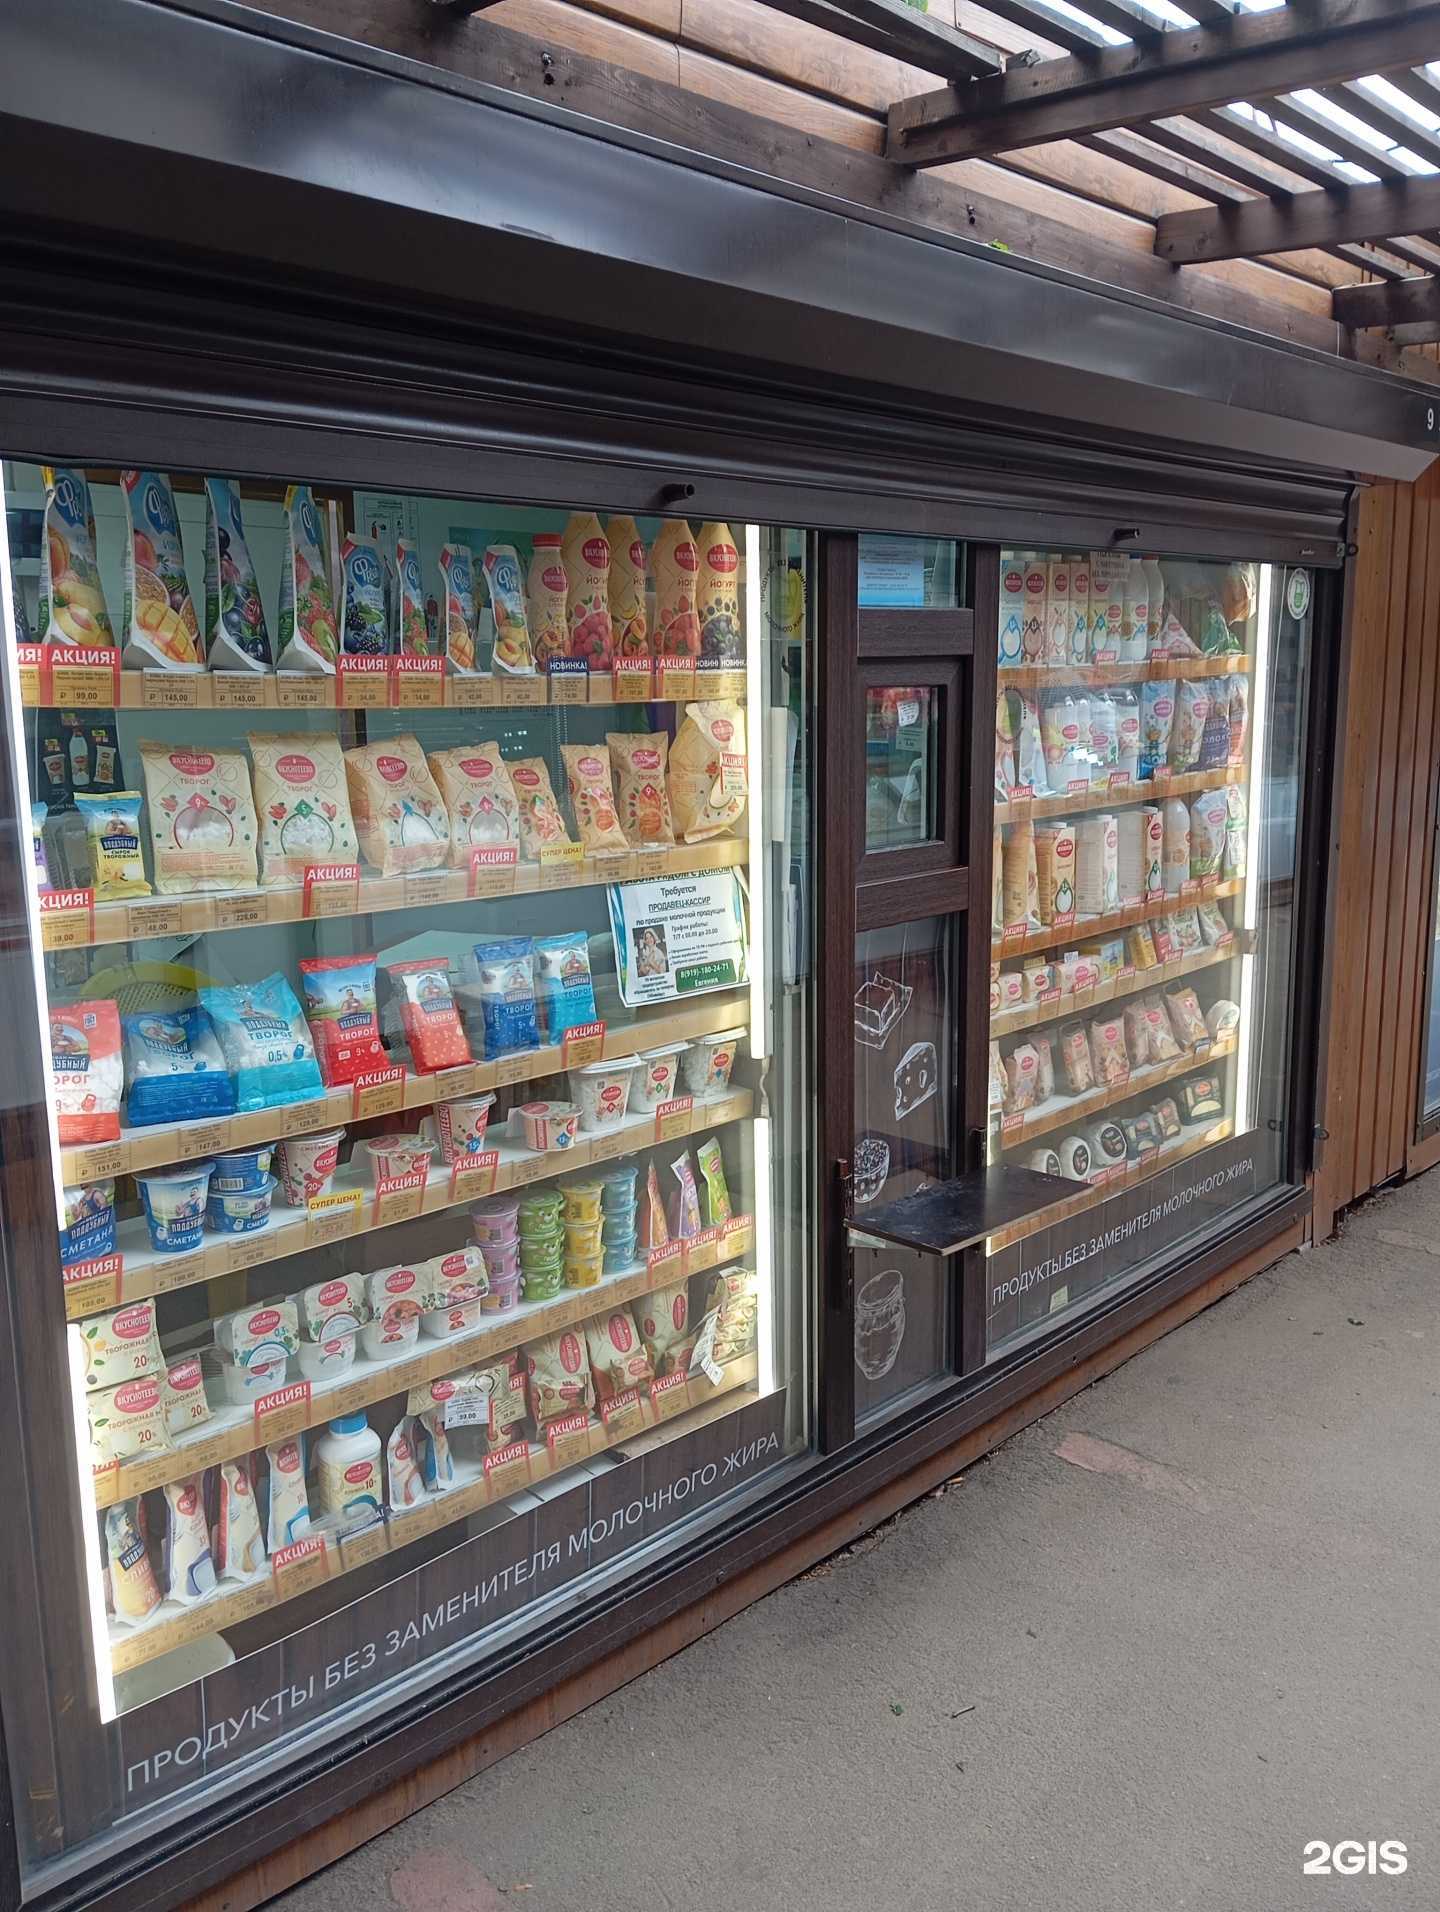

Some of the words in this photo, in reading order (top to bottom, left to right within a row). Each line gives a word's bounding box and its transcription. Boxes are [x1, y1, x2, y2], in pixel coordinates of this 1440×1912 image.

[1427, 407, 1434, 431] 9
[51, 650, 115, 665] АКЦИЯ!
[340, 659, 388, 671] АКЦИЯ!
[396, 658, 442, 671] АКЦИЯ!
[550, 661, 587, 670] НОВИНКА!
[615, 660, 652, 670] АКЦИЯ!
[660, 659, 694, 669] АКЦИЯ!
[473, 850, 514, 865] АКЦИЯ!
[307, 868, 357, 881] АКЦИЯ!
[660, 885, 697, 898] Требуется
[38, 892, 89, 909] КЦИЯ!
[249, 1031, 293, 1040] ТВОРОГ
[338, 1027, 375, 1040] ТВОРОГ
[566, 1024, 604, 1039] АКЦИЯ!
[54, 1074, 90, 1085] ОРОГ
[356, 1068, 403, 1088] АКЦИЯ!
[658, 1099, 692, 1115] АКЦИЯ!
[455, 1153, 496, 1170] АКЦИЯ!
[379, 1174, 424, 1194] АКЦИЯ!
[310, 1199, 335, 1210] СУПЕР
[337, 1194, 361, 1205] ЦЕНА!
[723, 1216, 752, 1233] АКЦИЯ!
[993, 1256, 1063, 1305] ПРОДУКТЫ
[1065, 1243, 1087, 1267] БЕЗ
[1088, 1205, 1161, 1258] ЗАМЕНИТЕЛЯ
[1163, 1175, 1225, 1217] МОЛОЧНОГО
[1225, 1158, 1254, 1184] ЖИРА
[60, 1225, 113, 1259] СМЕТАНА
[166, 1231, 202, 1246] СМЕТАН
[686, 1231, 716, 1248] АКЦИЯ!
[650, 1242, 682, 1262] АКЦИЯ!
[61, 1258, 119, 1280] АКЦИЯ!
[652, 1373, 685, 1394] АКЦИЯ!
[257, 1386, 308, 1412] АКЦИЯ!
[603, 1391, 639, 1414] АКЦИЯ!
[549, 1416, 586, 1437] АКЦИЯ!
[486, 1444, 526, 1469] АКЦИЯ!
[275, 1536, 323, 1567] АКЦИЯ!
[127, 1675, 314, 1792] ПРОДУКТЫ
[325, 1643, 377, 1690] БЕЗ
[385, 1541, 561, 1657] ЗАМЕНИТЕЛЯ
[568, 1463, 718, 1557] МОЛОЧНОГО
[722, 1431, 779, 1476] ЖИРА
